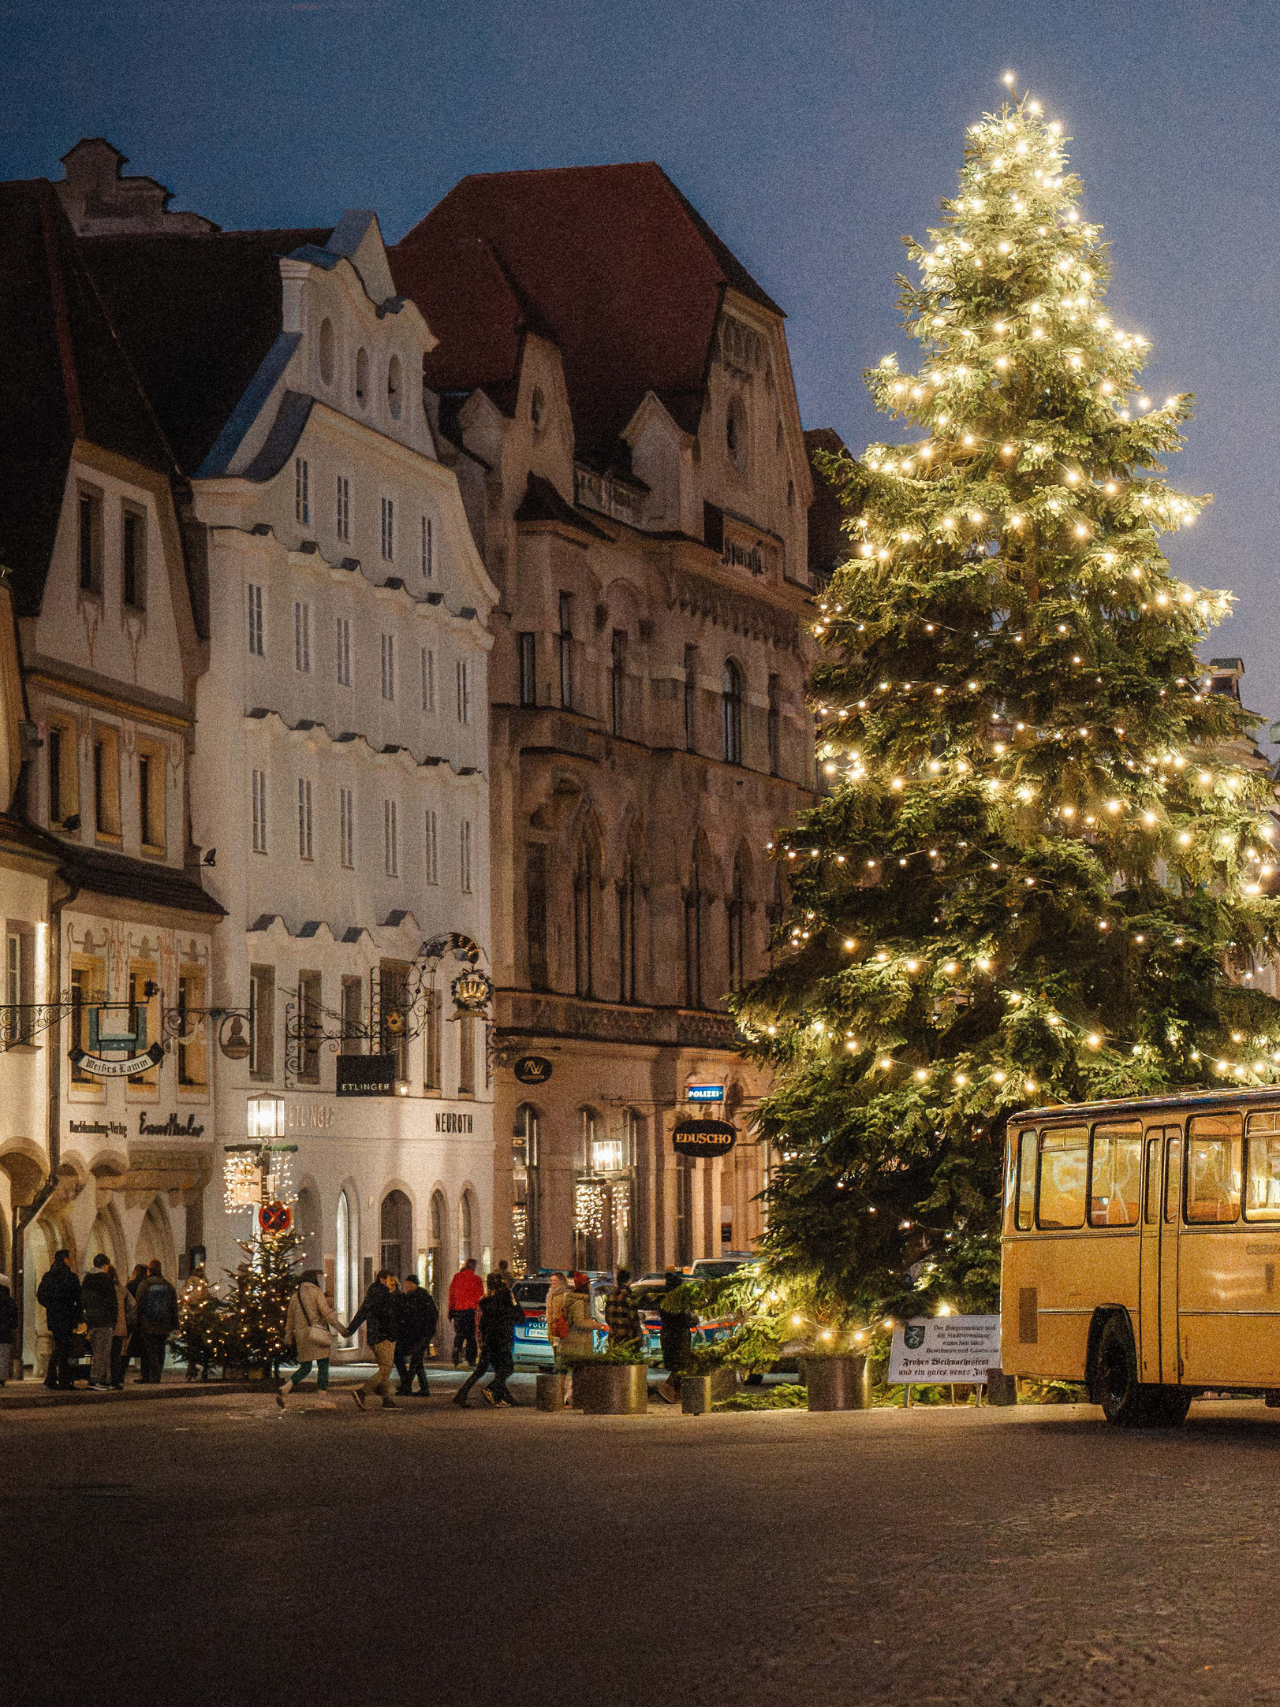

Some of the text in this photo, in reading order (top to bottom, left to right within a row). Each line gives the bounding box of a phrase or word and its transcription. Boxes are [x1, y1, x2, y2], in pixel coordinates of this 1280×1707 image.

[85, 1058, 149, 1074] Weißes Lamm
[341, 1083, 390, 1091] ETLINGER
[435, 1112, 473, 1133] NEUROTH
[675, 1132, 732, 1144] EDUSCHO
